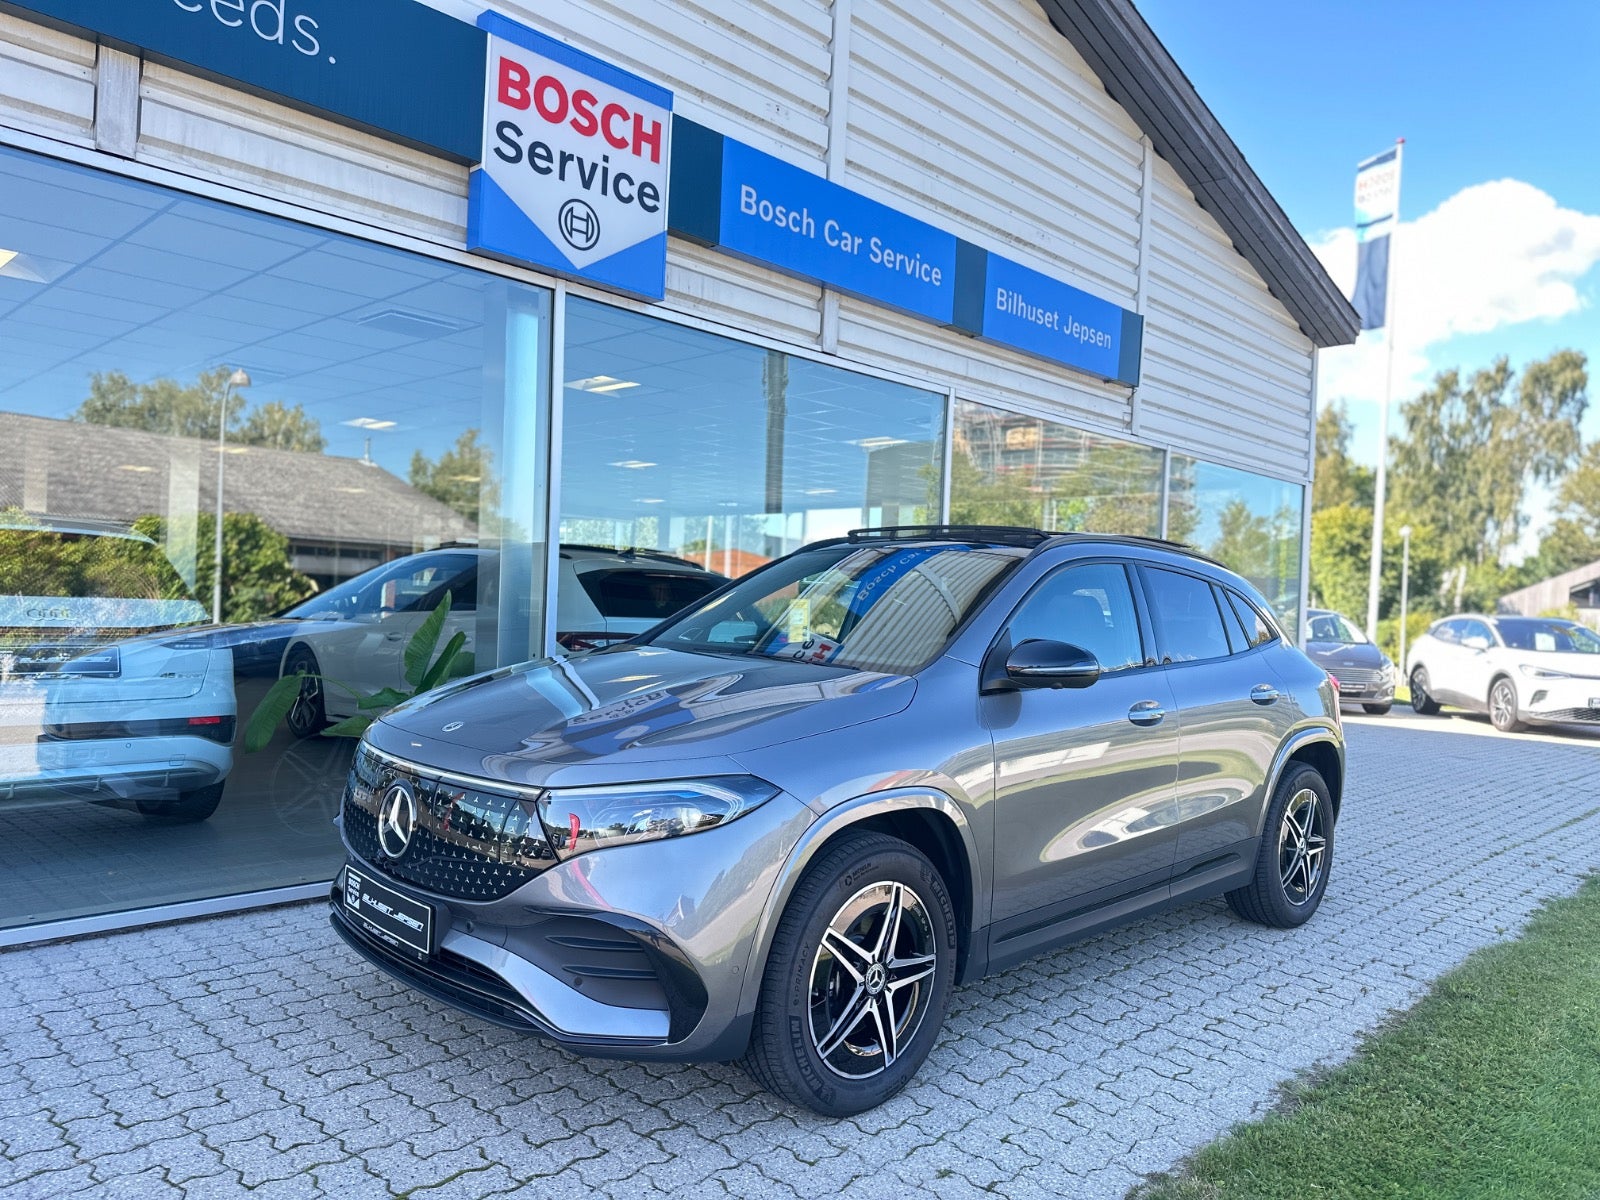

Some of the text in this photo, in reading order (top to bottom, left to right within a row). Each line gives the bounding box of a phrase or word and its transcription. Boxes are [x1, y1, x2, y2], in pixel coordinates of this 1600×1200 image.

[497, 55, 662, 163] BOSCH
[494, 121, 661, 213] Service
[740, 184, 943, 286] Bosch Car Service
[996, 287, 1112, 350] Bilhuset Jepsen
